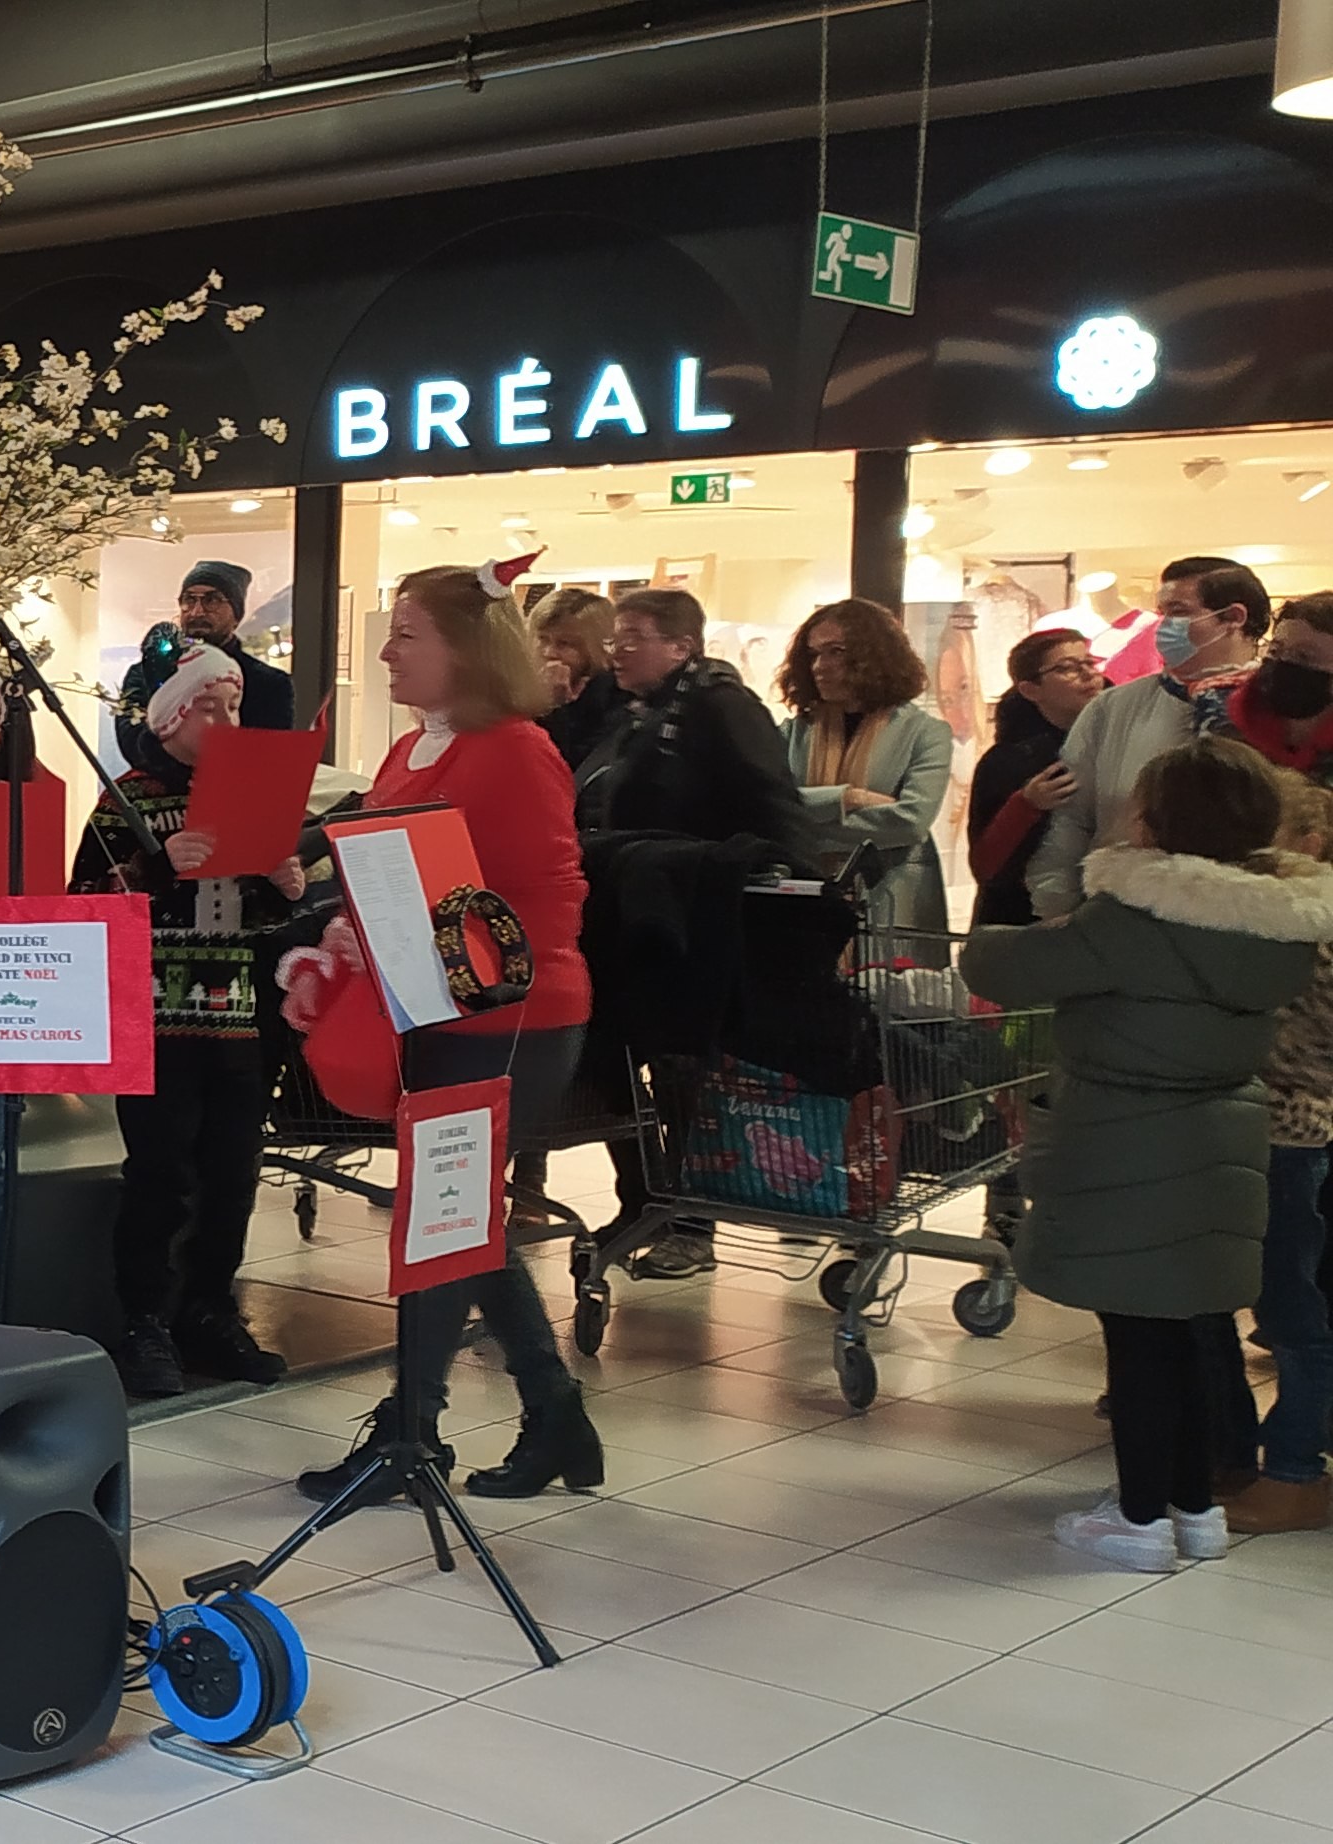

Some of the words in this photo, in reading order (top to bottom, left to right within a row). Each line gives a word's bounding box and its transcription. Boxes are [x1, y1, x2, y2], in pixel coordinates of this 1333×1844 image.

[336, 356, 734, 459] BRÉAL
[14, 953, 32, 964] DE
[32, 953, 72, 964] VINCI
[17, 1016, 36, 1025] LES
[29, 1029, 83, 1041] CAROLS
